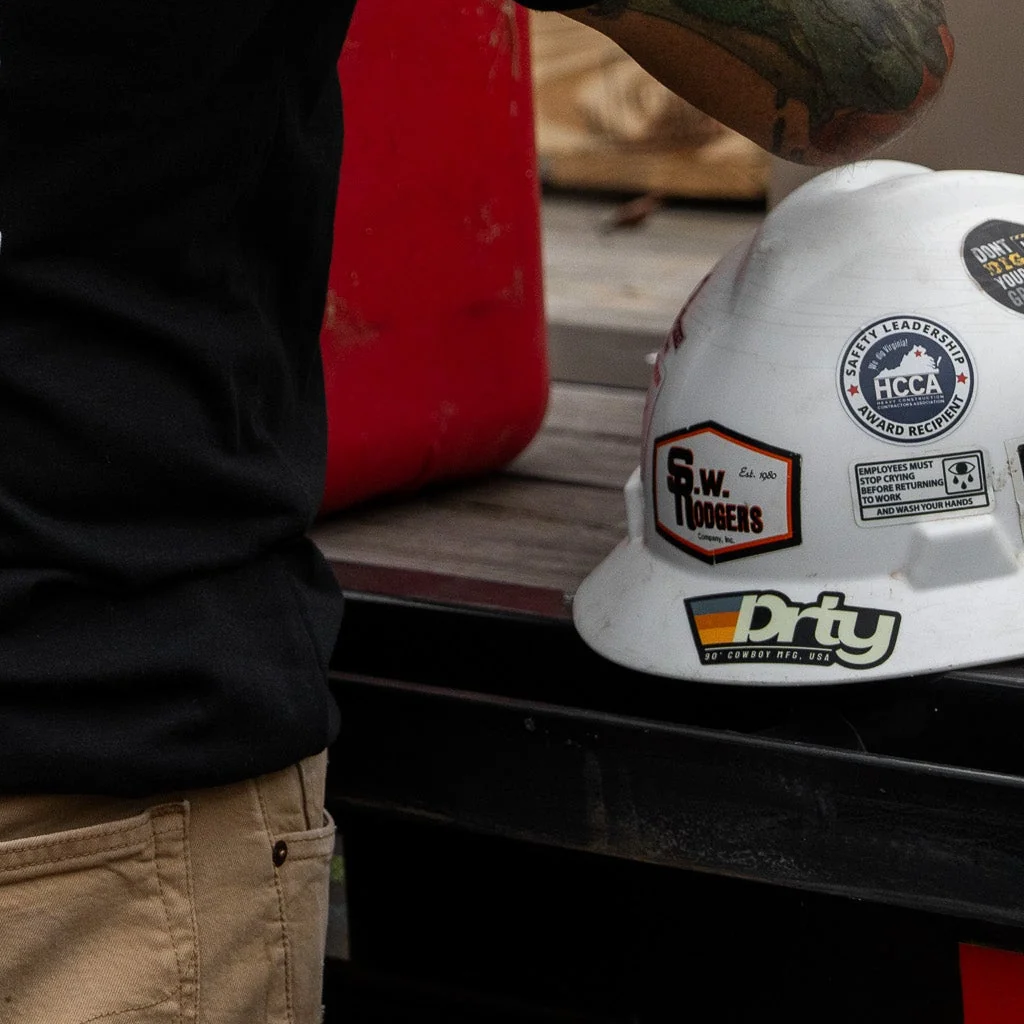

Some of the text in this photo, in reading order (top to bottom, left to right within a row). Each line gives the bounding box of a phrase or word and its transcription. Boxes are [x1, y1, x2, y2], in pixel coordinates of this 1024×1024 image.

[846, 320, 965, 377] SAFETY LEADERSHIP
[874, 373, 943, 400] HCCA
[857, 394, 964, 436] AWARD RECIPIENT
[738, 467, 756, 479] Est.
[859, 461, 934, 476] EMPLOYEES MUST
[860, 472, 916, 486] STOP CRYING
[861, 478, 944, 495] BEFORE RETURNING
[675, 474, 764, 534] RODGERS
[862, 493, 902, 504] TO WORK
[877, 498, 973, 516] AND WASH YOUR HANDS
[732, 593, 896, 665] Drty
[728, 650, 772, 661] COWBOY
[808, 652, 830, 662] USA
